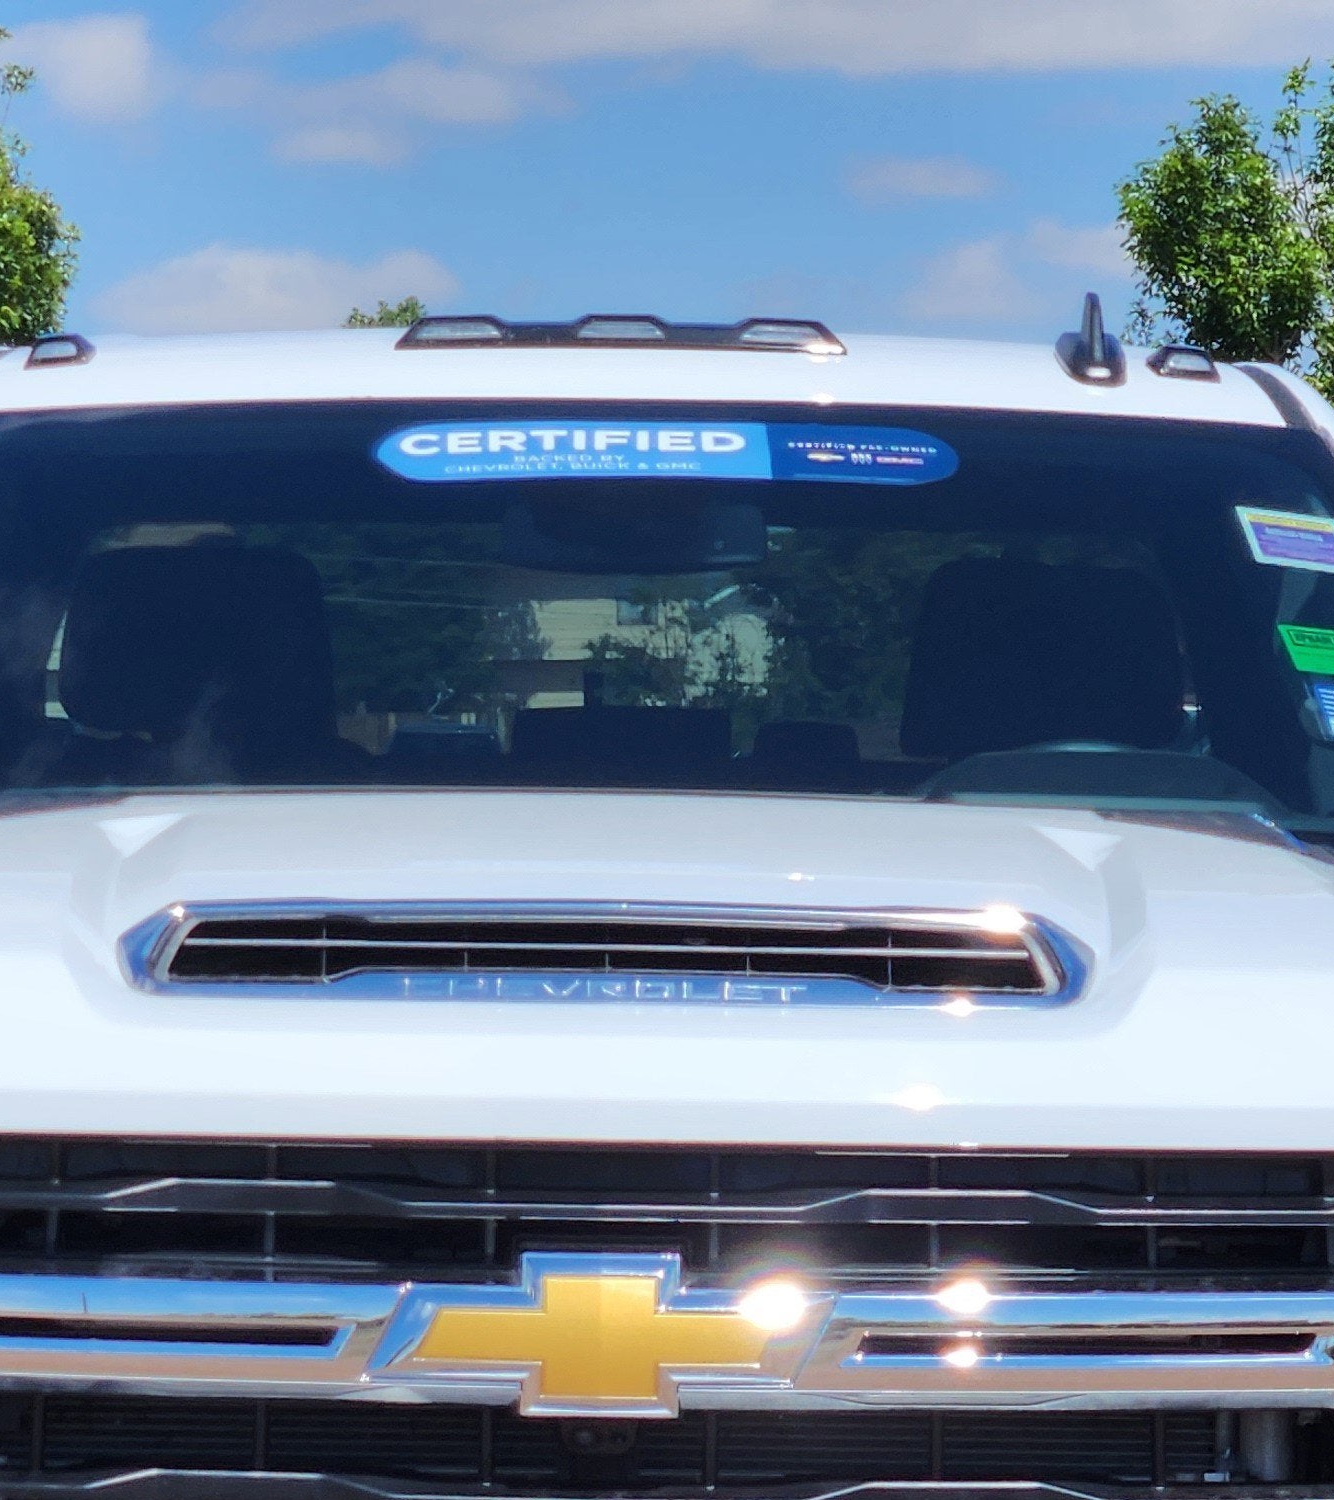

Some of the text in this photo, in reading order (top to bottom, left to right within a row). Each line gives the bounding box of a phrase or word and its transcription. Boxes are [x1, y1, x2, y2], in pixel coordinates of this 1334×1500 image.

[399, 429, 747, 455] CERTIFIED
[514, 453, 625, 464] BACKED BY
[570, 461, 630, 471] BUICK
[637, 462, 650, 470] &
[656, 462, 702, 471] GMC
